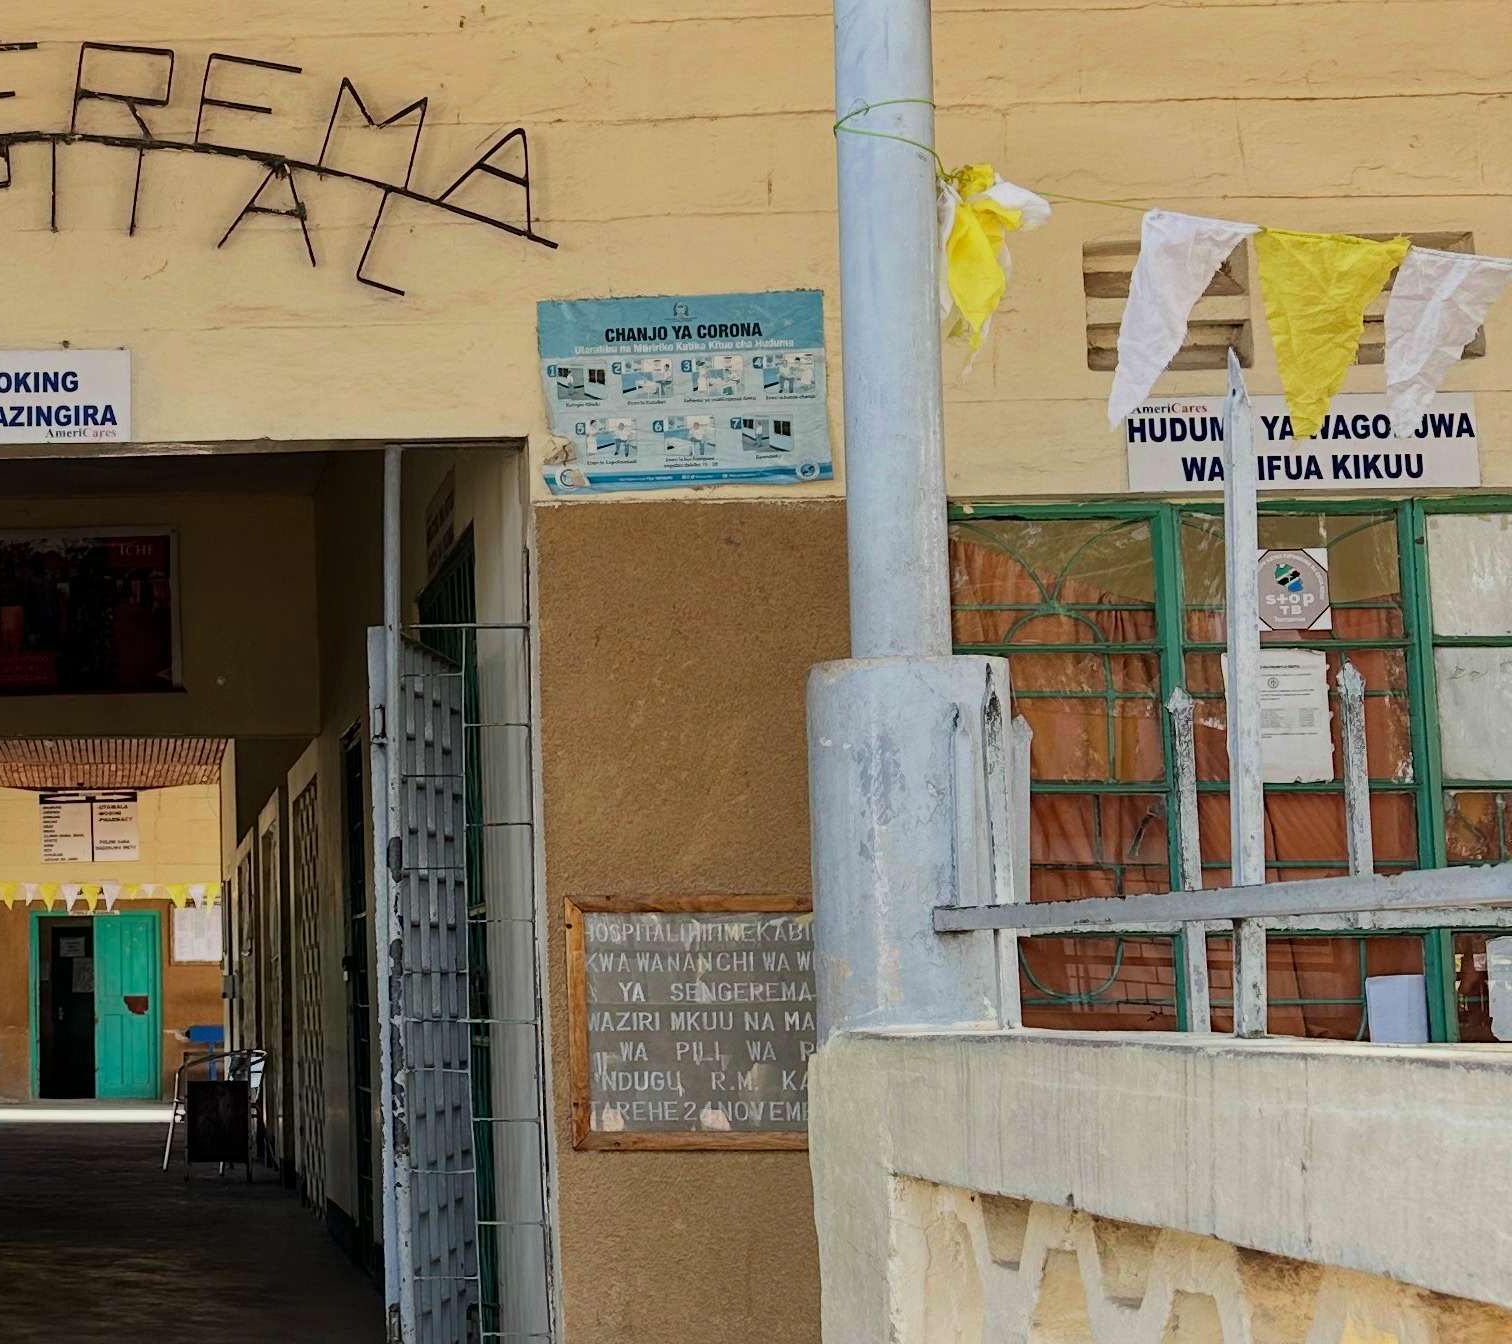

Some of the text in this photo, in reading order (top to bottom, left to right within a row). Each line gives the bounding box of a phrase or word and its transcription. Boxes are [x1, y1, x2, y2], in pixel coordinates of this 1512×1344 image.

[604, 322, 763, 343] CHANJO YA CORONA
[1132, 402, 1208, 415] AmeriCares
[45, 427, 118, 441] AmeriCares
[1127, 413, 1476, 443] HUDUM YA WAGOJWA
[1181, 453, 1424, 482] WA IFUA KIKUU
[1265, 593, 1315, 607] stop
[1279, 605, 1303, 616] TB
[586, 952, 631, 973] KWA
[637, 952, 755, 973] WANANCHI
[762, 951, 791, 973] WA
[617, 981, 814, 1003] YA SENGEREMA
[589, 1010, 661, 1032] WAZIRI
[670, 1011, 734, 1032] MKUU
[743, 1010, 776, 1032] NA
[619, 1040, 649, 1062] WA
[745, 1039, 777, 1062] WA
[601, 1070, 682, 1092] NDUGU
